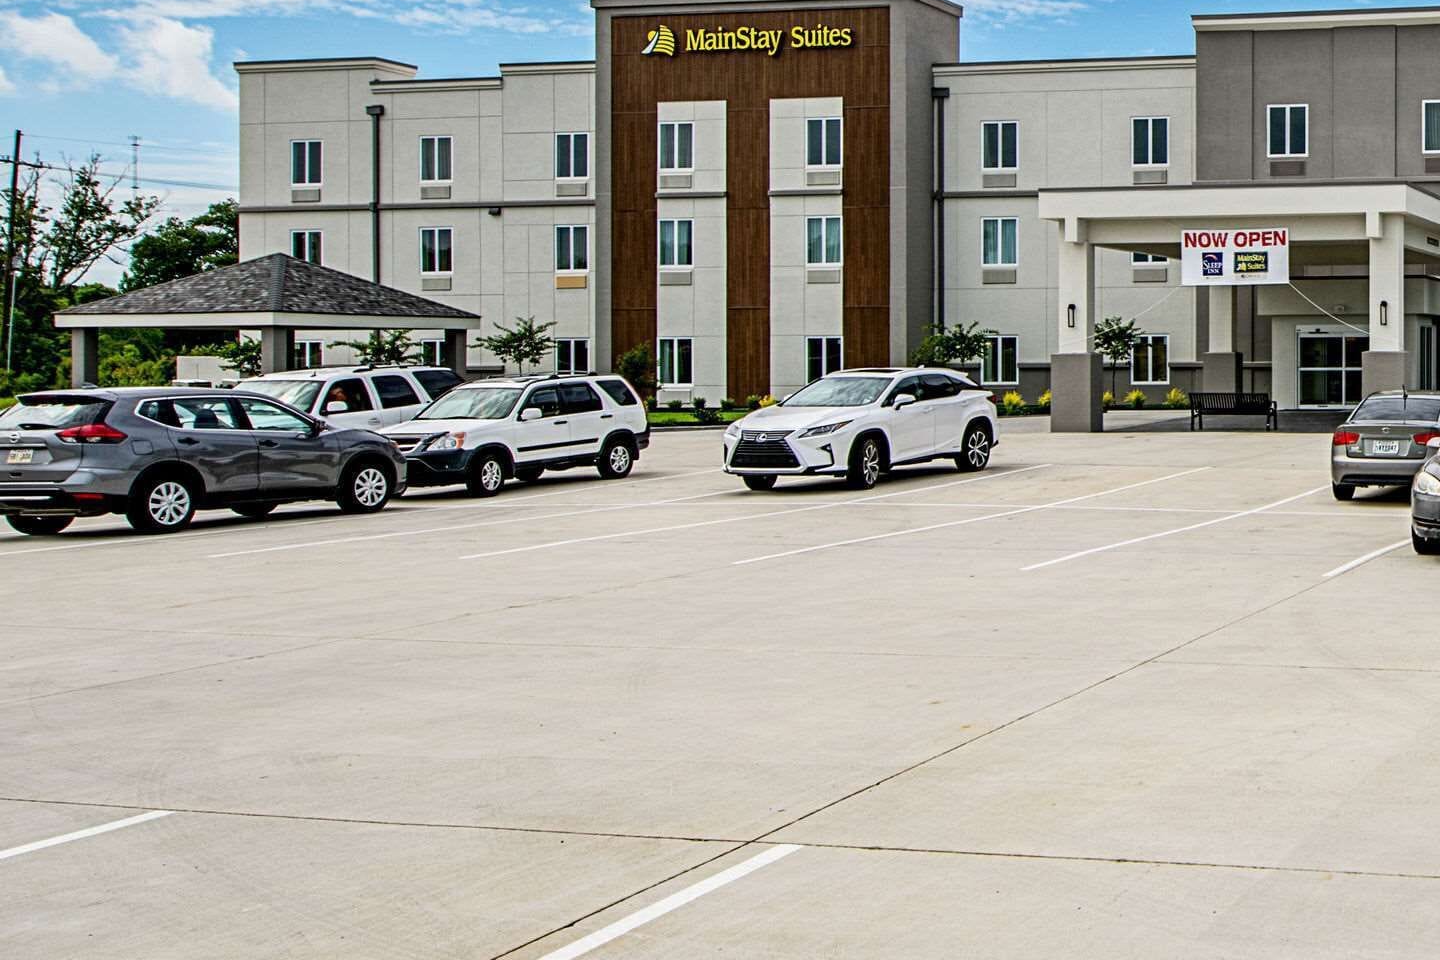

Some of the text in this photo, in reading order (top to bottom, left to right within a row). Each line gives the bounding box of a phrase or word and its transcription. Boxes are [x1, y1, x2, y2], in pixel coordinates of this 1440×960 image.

[685, 23, 852, 56] MainStay Suites
[1184, 230, 1287, 249] NOW OPEN
